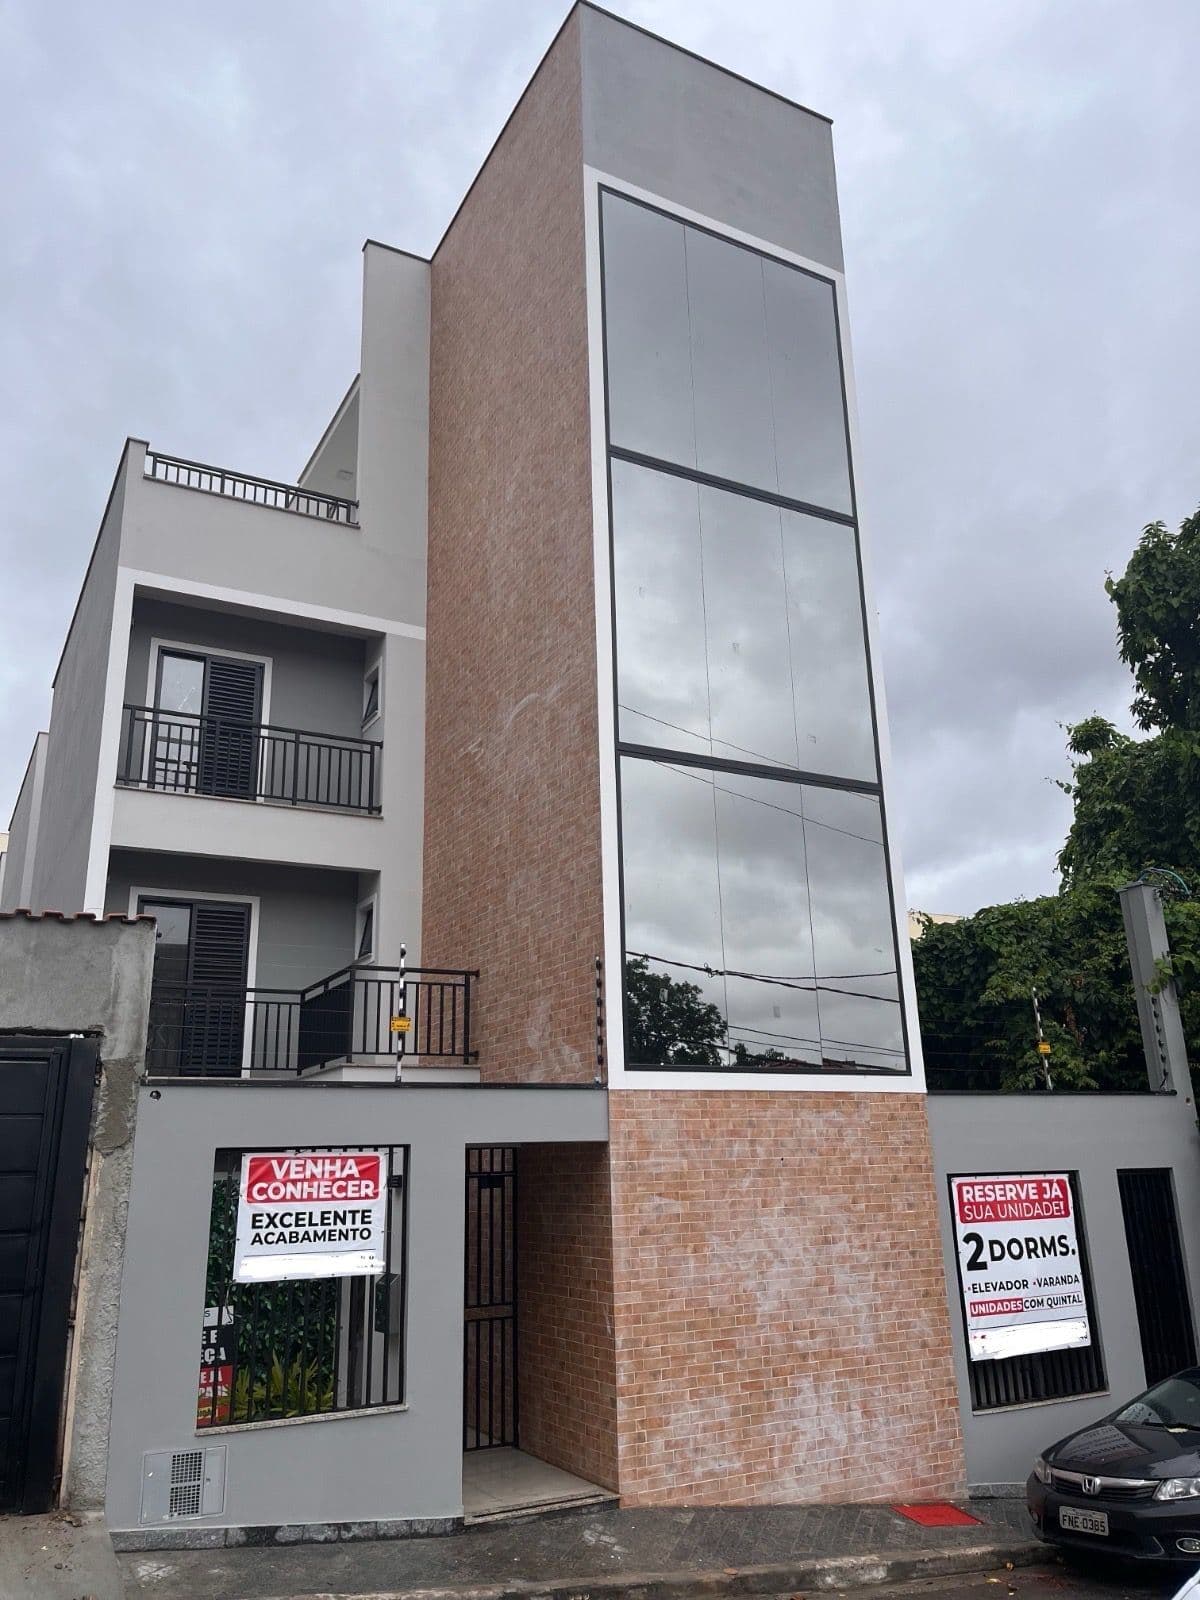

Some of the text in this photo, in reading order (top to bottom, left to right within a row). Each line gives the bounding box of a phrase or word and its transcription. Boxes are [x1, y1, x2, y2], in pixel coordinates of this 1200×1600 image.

[271, 1158, 360, 1179] VENHA
[252, 1180, 375, 1200] CONHECER
[962, 1179, 1063, 1203] RESERVE JÁ
[251, 1209, 372, 1229] EXCELENTE
[964, 1201, 1065, 1220] SUA UNIDADE!
[250, 1228, 372, 1245] ACABAMENTO
[962, 1232, 1076, 1271] 2 DORMS.
[972, 1274, 1080, 1293] ELEVADOR VARANDA
[971, 1294, 1083, 1315] UNIDADES COM QUINTAL
